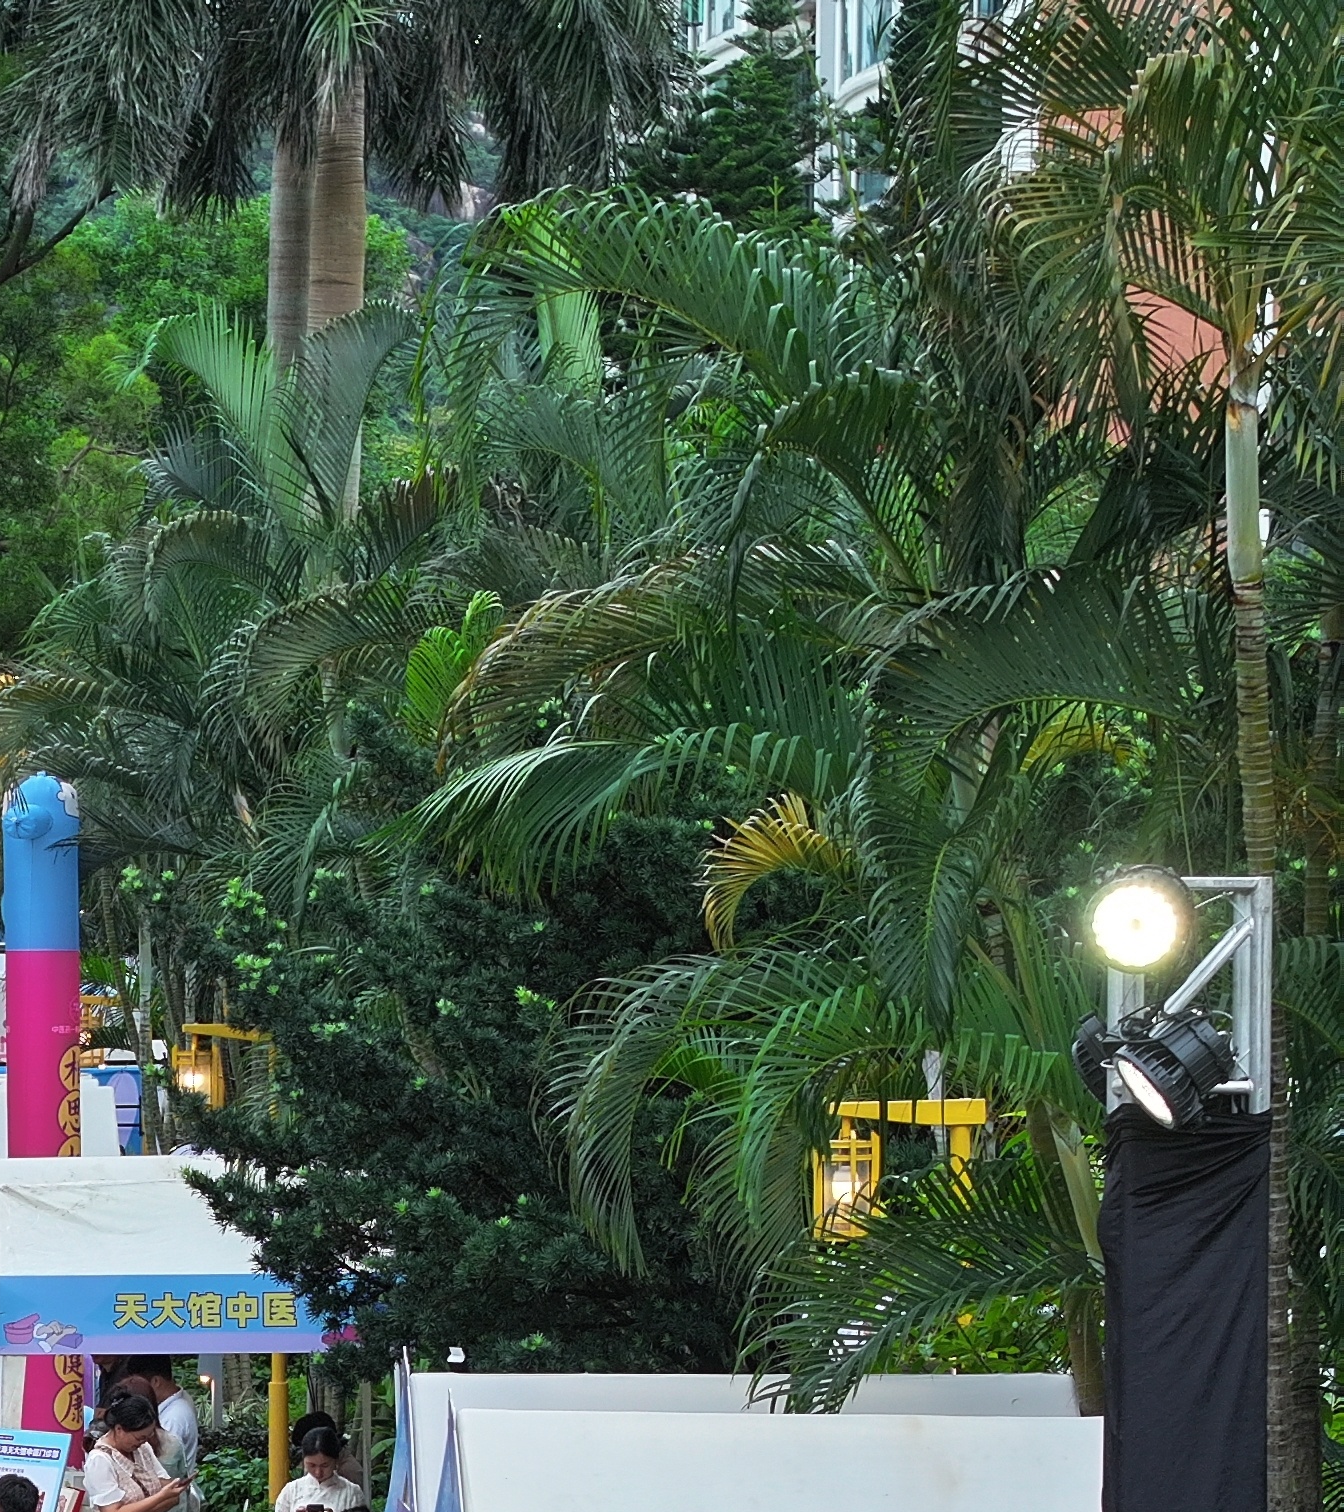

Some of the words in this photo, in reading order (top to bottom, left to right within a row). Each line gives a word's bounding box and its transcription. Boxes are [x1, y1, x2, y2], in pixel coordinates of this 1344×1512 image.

[113, 1291, 300, 1330] 天大馆中医
